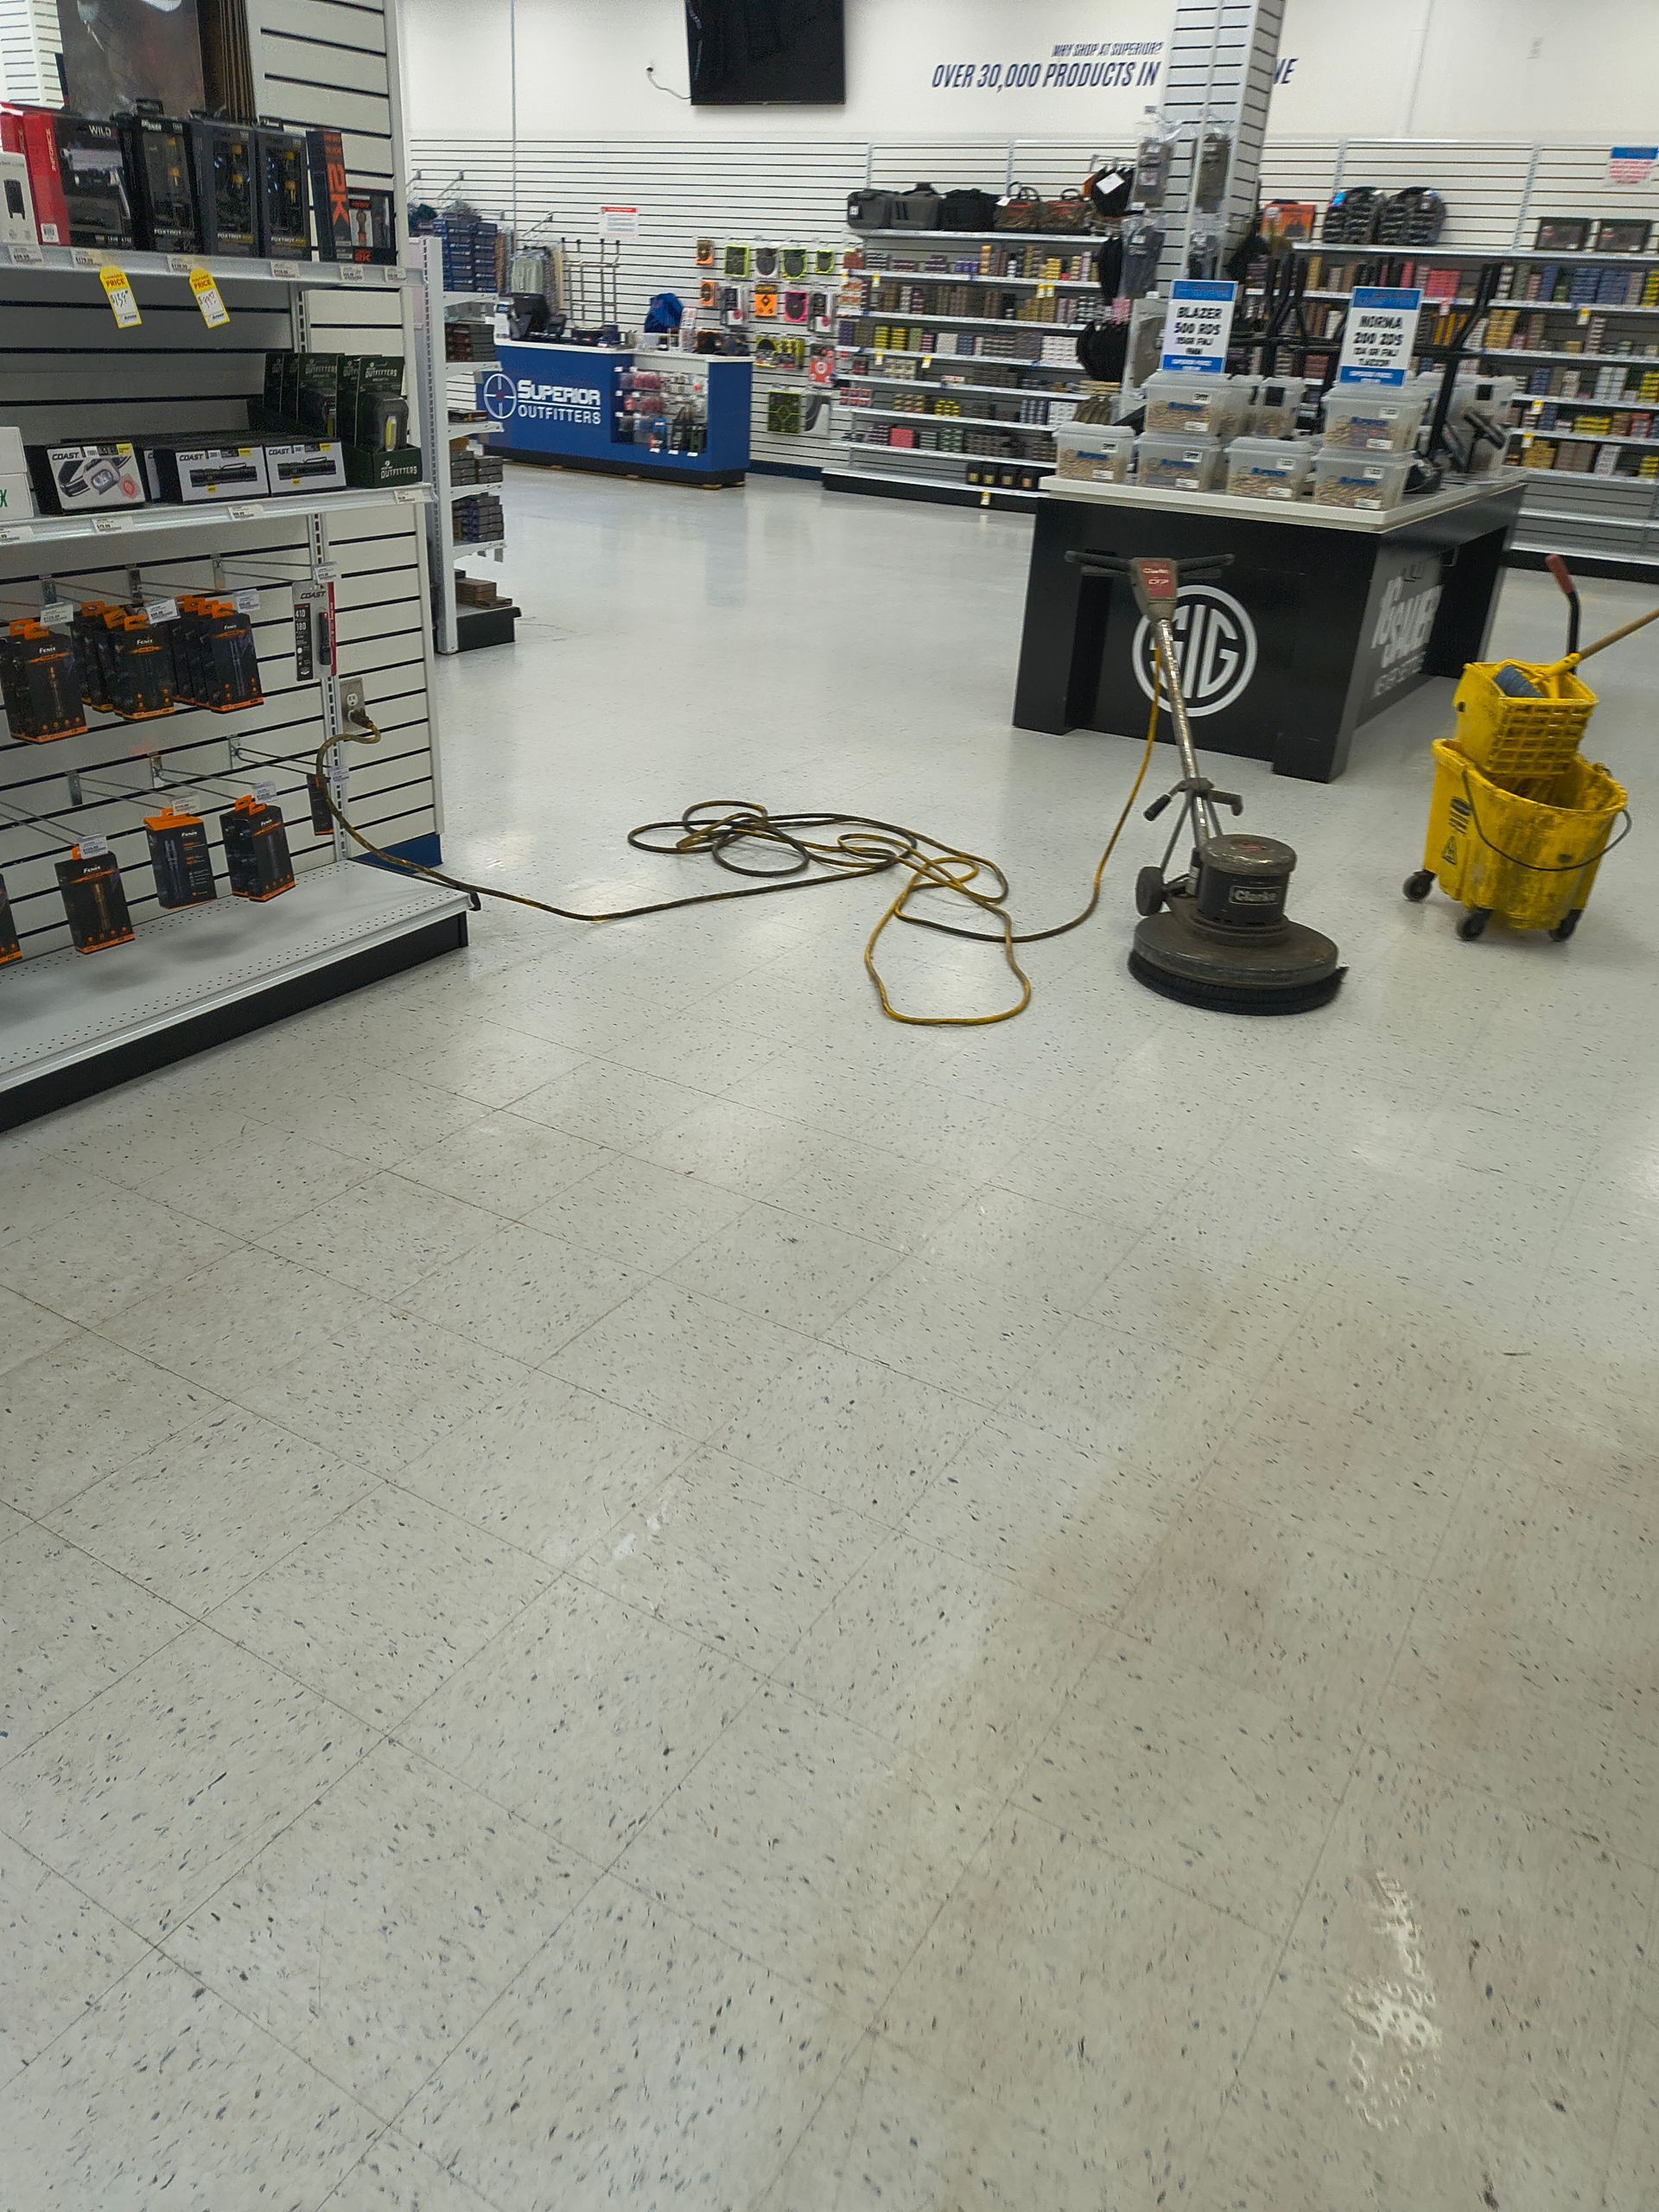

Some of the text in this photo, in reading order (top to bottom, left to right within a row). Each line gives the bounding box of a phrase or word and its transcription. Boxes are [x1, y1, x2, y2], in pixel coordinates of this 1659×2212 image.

[1073, 43, 1098, 56] SHOP
[931, 63, 976, 87] OVER
[976, 63, 1042, 92] 30,000
[1042, 61, 1136, 87] PRODUCTS
[1136, 60, 1162, 86] IN
[105, 277, 125, 287] PRICE
[194, 281, 212, 289] PRICE
[1176, 306, 1223, 320] BLAZER
[1173, 321, 1197, 334] 500
[365, 368, 397, 378] OUTFITTERS
[517, 379, 601, 406] SUPERIOR
[518, 404, 601, 424] OUTFITTERS
[52, 452, 79, 461] COAST
[179, 453, 204, 461] COAST
[268, 448, 290, 456] COAST
[380, 465, 417, 479] OUTFITTERS
[300, 590, 327, 600] COAST
